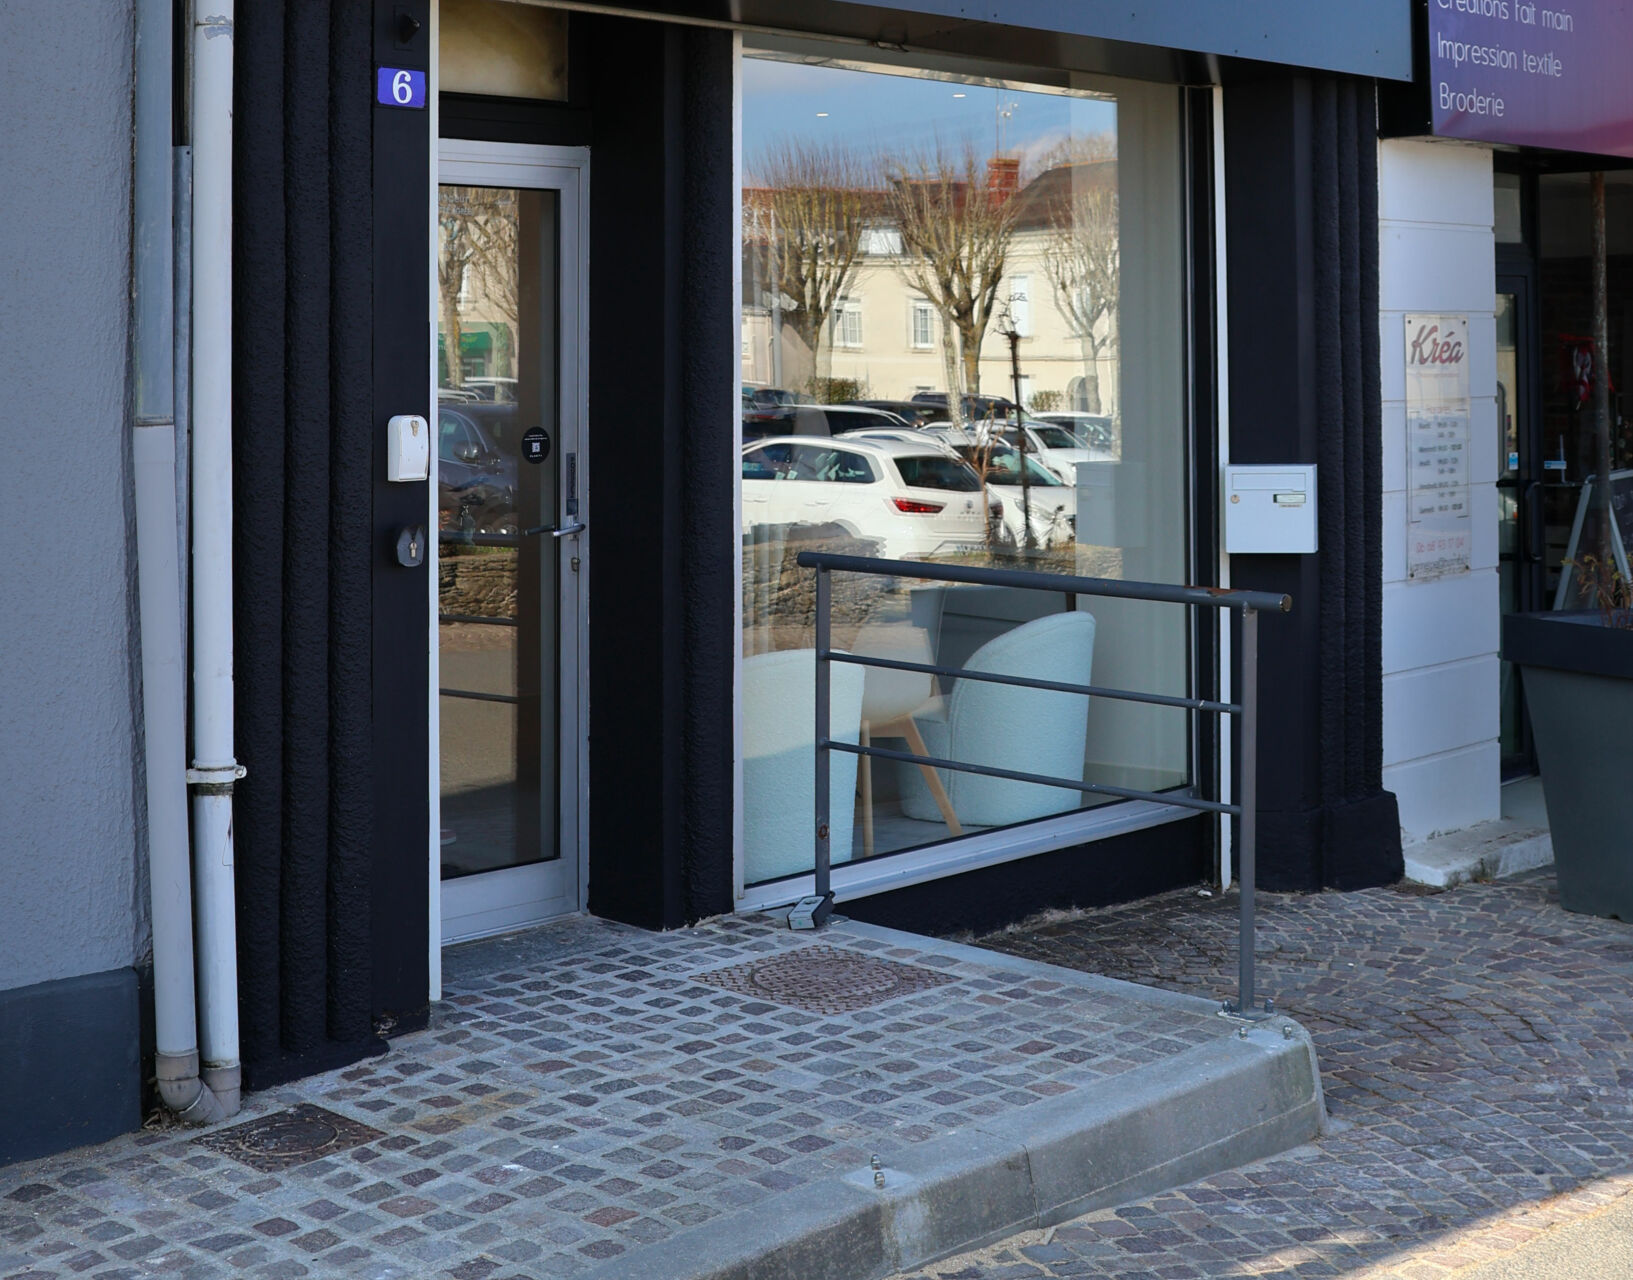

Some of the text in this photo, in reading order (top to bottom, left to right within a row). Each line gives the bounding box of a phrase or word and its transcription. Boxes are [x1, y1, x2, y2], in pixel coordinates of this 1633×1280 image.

[1542, 9, 1574, 32] main
[1437, 31, 1563, 78] Impression textile
[392, 70, 413, 104] 6
[1439, 82, 1505, 118] Broderie
[1410, 324, 1464, 365] Kréa
